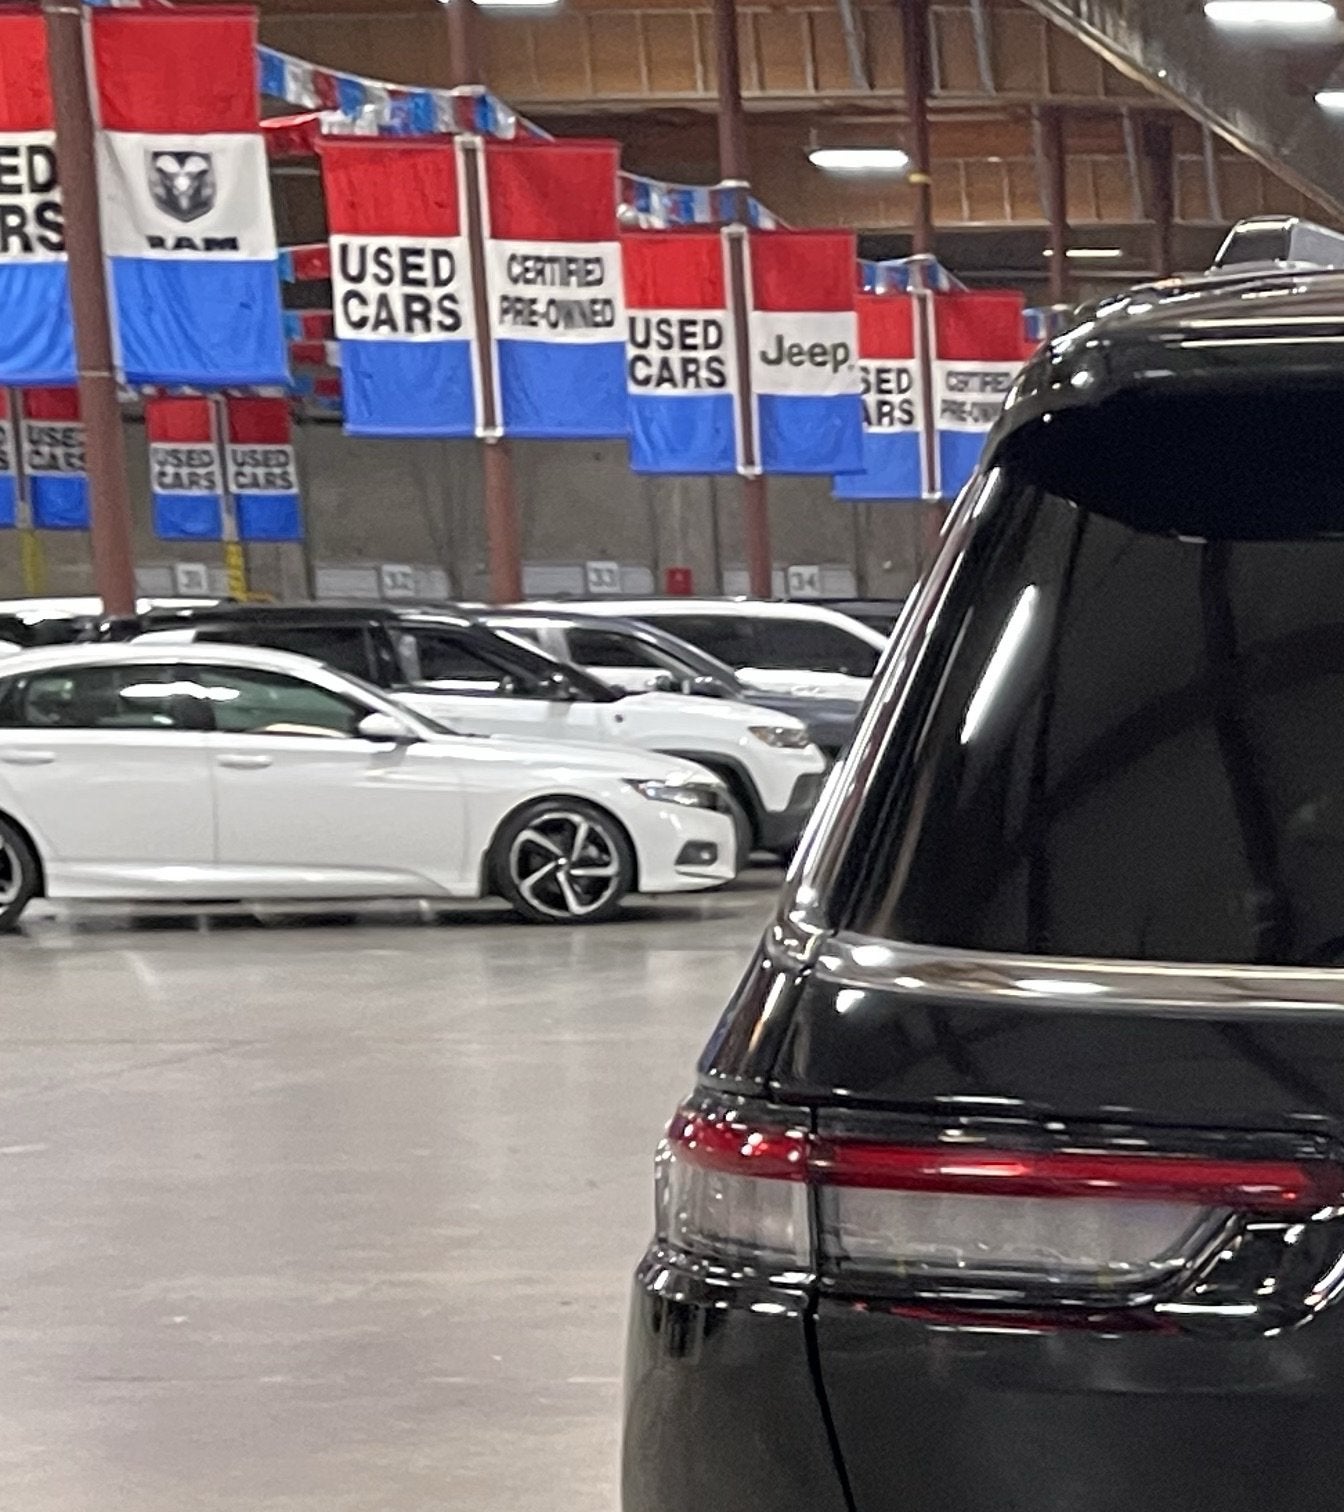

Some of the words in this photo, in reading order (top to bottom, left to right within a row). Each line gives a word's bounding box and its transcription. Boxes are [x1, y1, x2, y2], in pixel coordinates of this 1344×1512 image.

[0, 144, 58, 194] ED
[0, 201, 66, 253] RS
[145, 234, 240, 252] RAM
[339, 244, 456, 287] USED
[507, 253, 605, 288] CERTIFIED
[343, 290, 463, 332] CARS
[499, 295, 615, 329] PRE-OWNED
[628, 317, 724, 351] USED
[759, 334, 850, 373] Jeep
[629, 354, 727, 389] CARS
[860, 366, 913, 395] SED
[28, 425, 82, 447] USE
[156, 448, 214, 468] USED
[232, 449, 289, 468] USED
[157, 471, 216, 489] CARS
[235, 471, 294, 489] CARS
